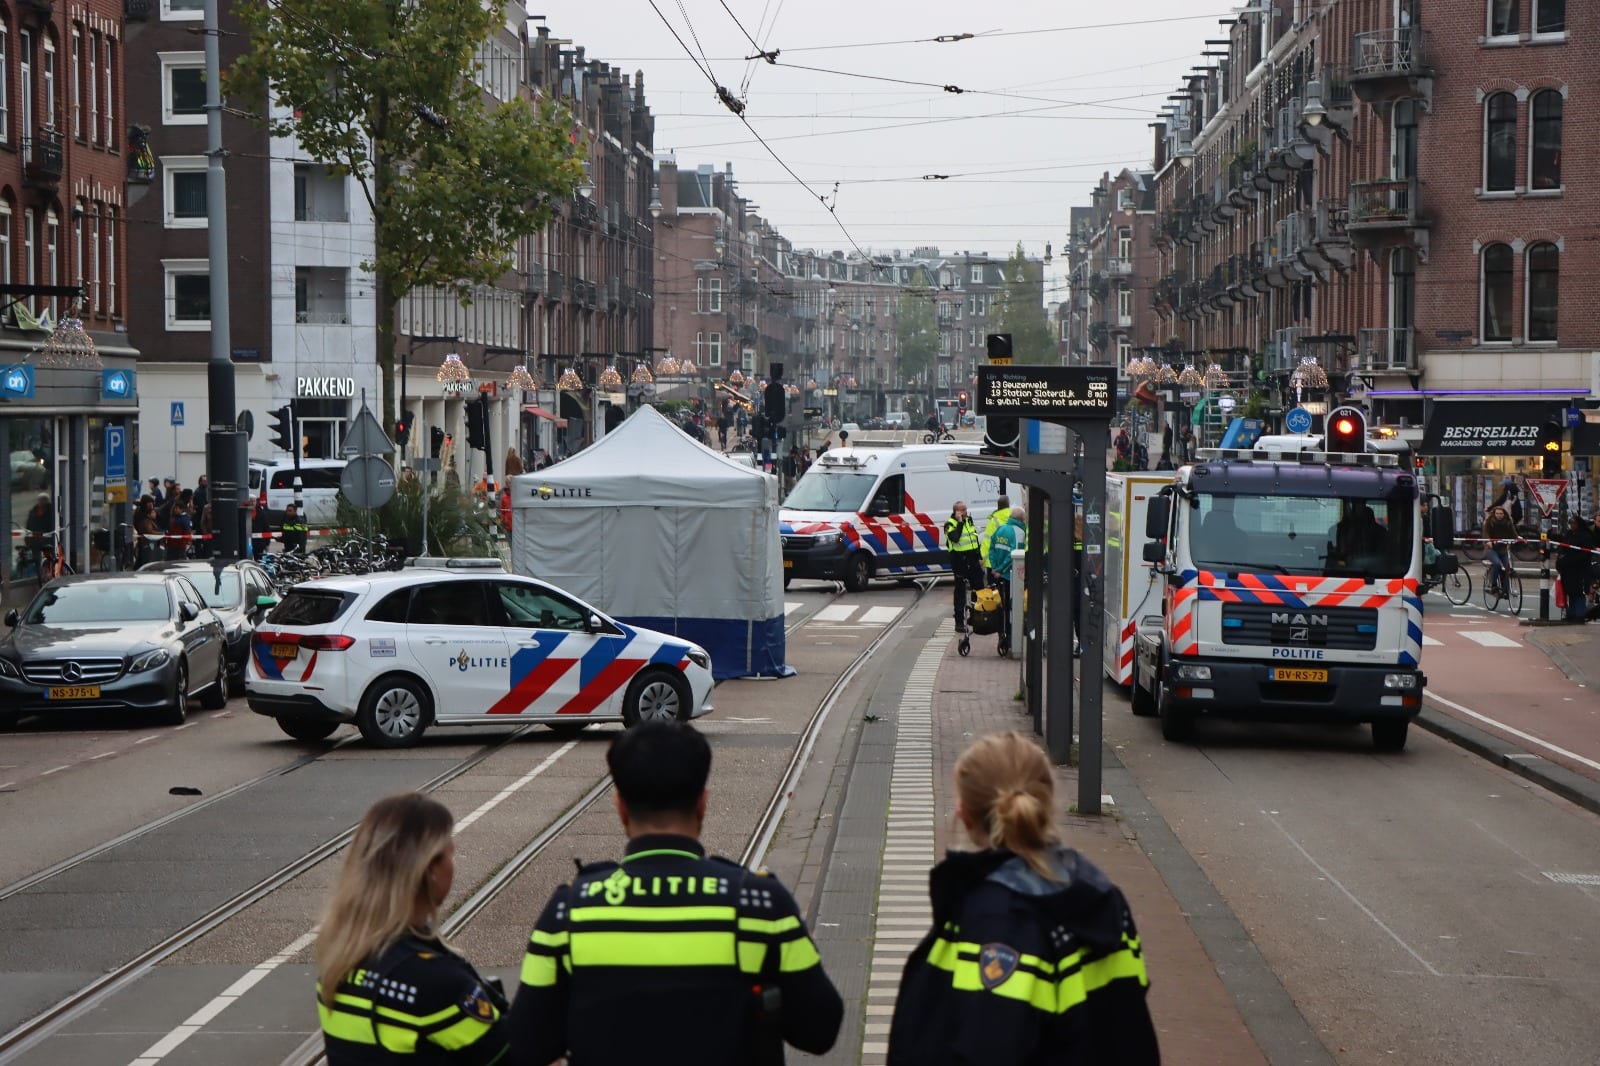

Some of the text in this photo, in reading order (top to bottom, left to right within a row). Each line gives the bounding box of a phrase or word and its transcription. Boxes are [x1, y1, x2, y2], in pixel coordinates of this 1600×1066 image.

[297, 376, 355, 397] PAKKEND
[1002, 381, 1048, 389] Geuzenveld
[1002, 389, 1032, 397] Station
[1034, 389, 1075, 398] Sloterdijk
[1031, 398, 1050, 406] Stop
[1052, 398, 1066, 406] not
[1068, 398, 1096, 406] served
[1097, 398, 1108, 407] by
[1443, 426, 1539, 438] BESTSELLER
[110, 431, 121, 457] P
[531, 486, 592, 500] POLITIE
[1271, 612, 1328, 626] MAN
[1272, 648, 1324, 660] POLITIE
[449, 656, 507, 672] POLITIE
[1278, 669, 1325, 681] BV-RS-73
[588, 874, 718, 905] POLITIE
